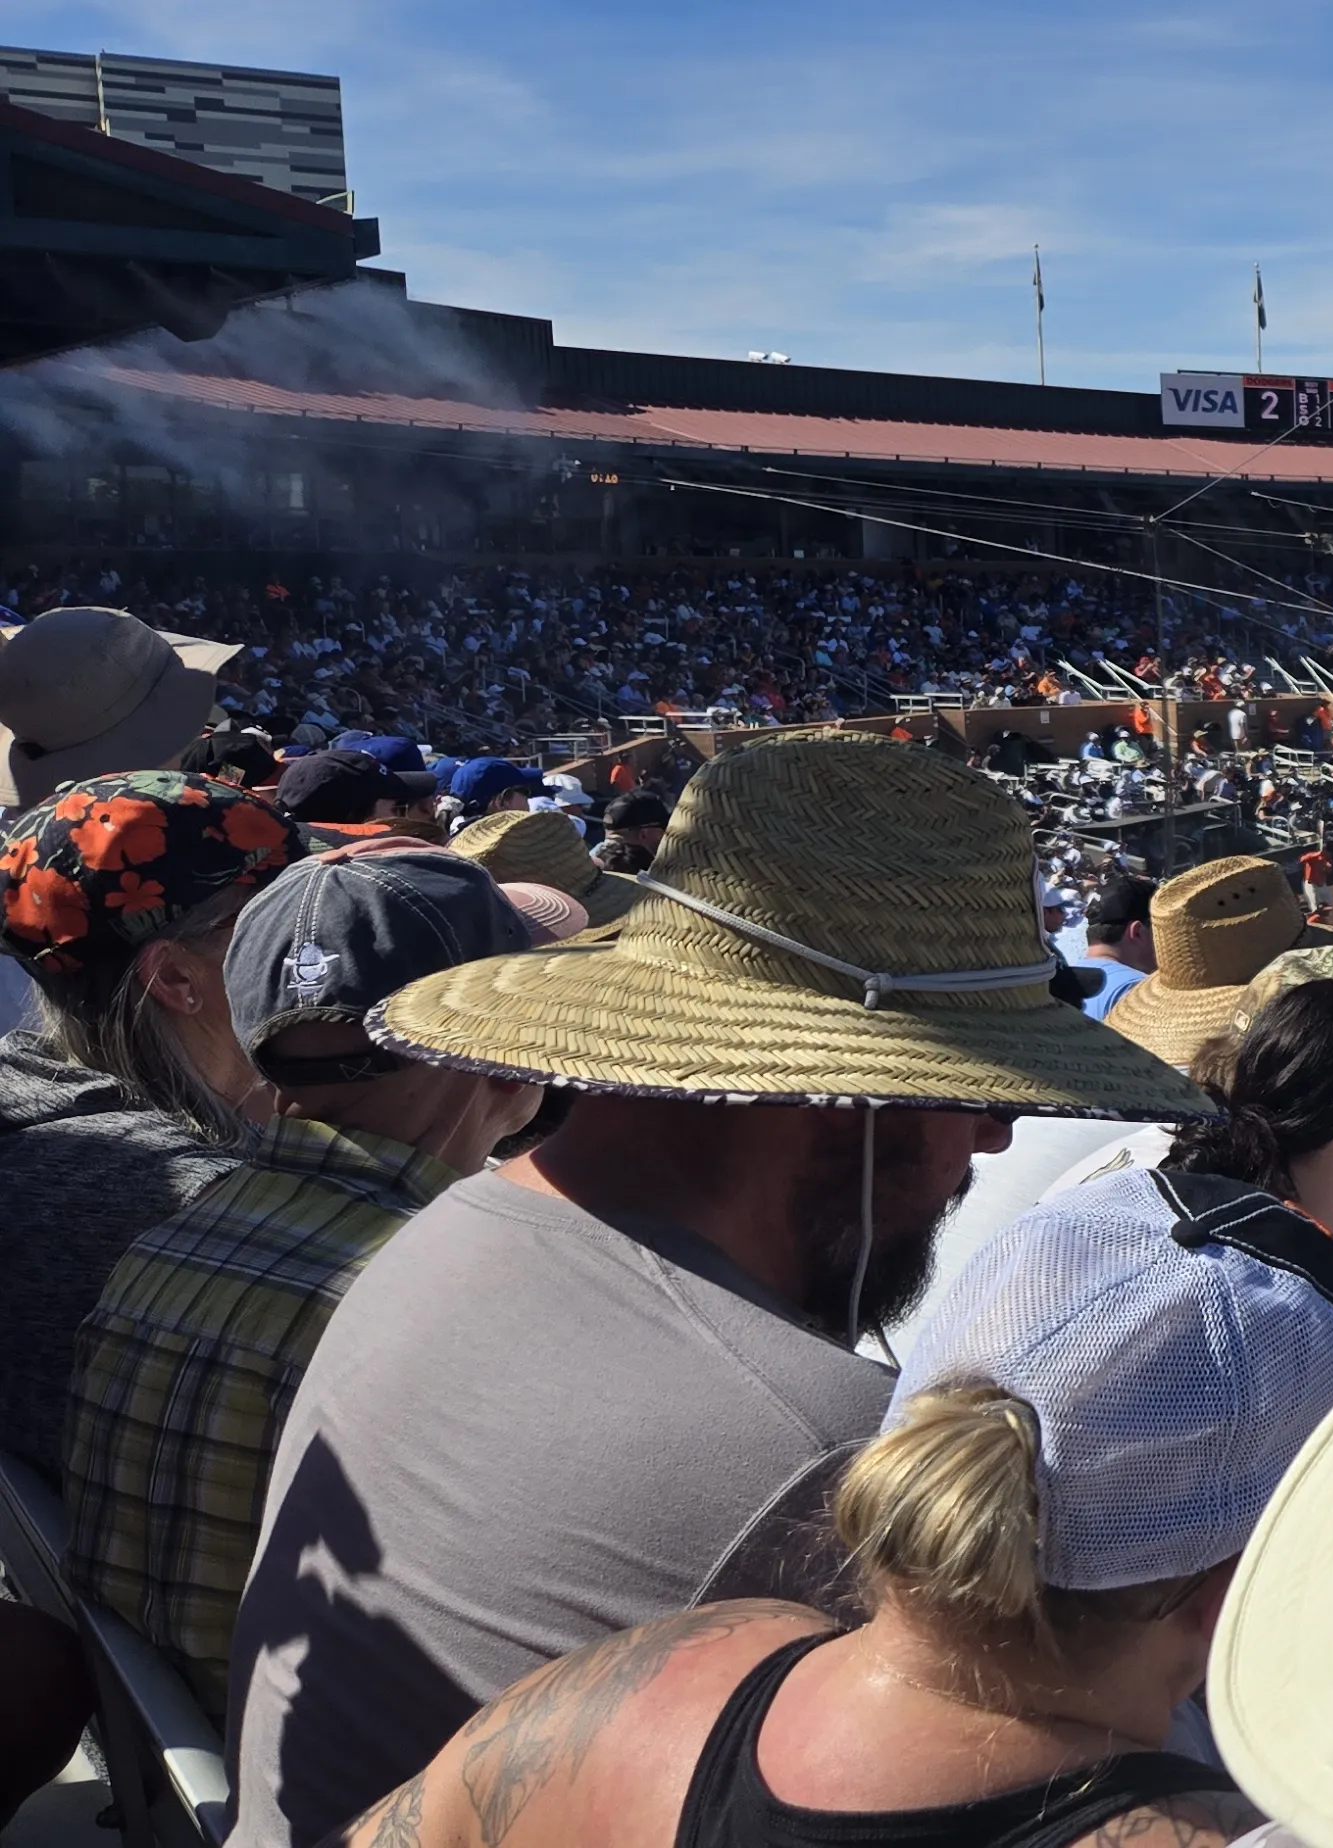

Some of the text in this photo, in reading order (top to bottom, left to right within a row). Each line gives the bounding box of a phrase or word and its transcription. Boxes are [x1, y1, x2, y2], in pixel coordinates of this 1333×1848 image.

[1167, 387, 1238, 414] VISA
[1260, 391, 1279, 420] 2
[1299, 393, 1308, 404] B
